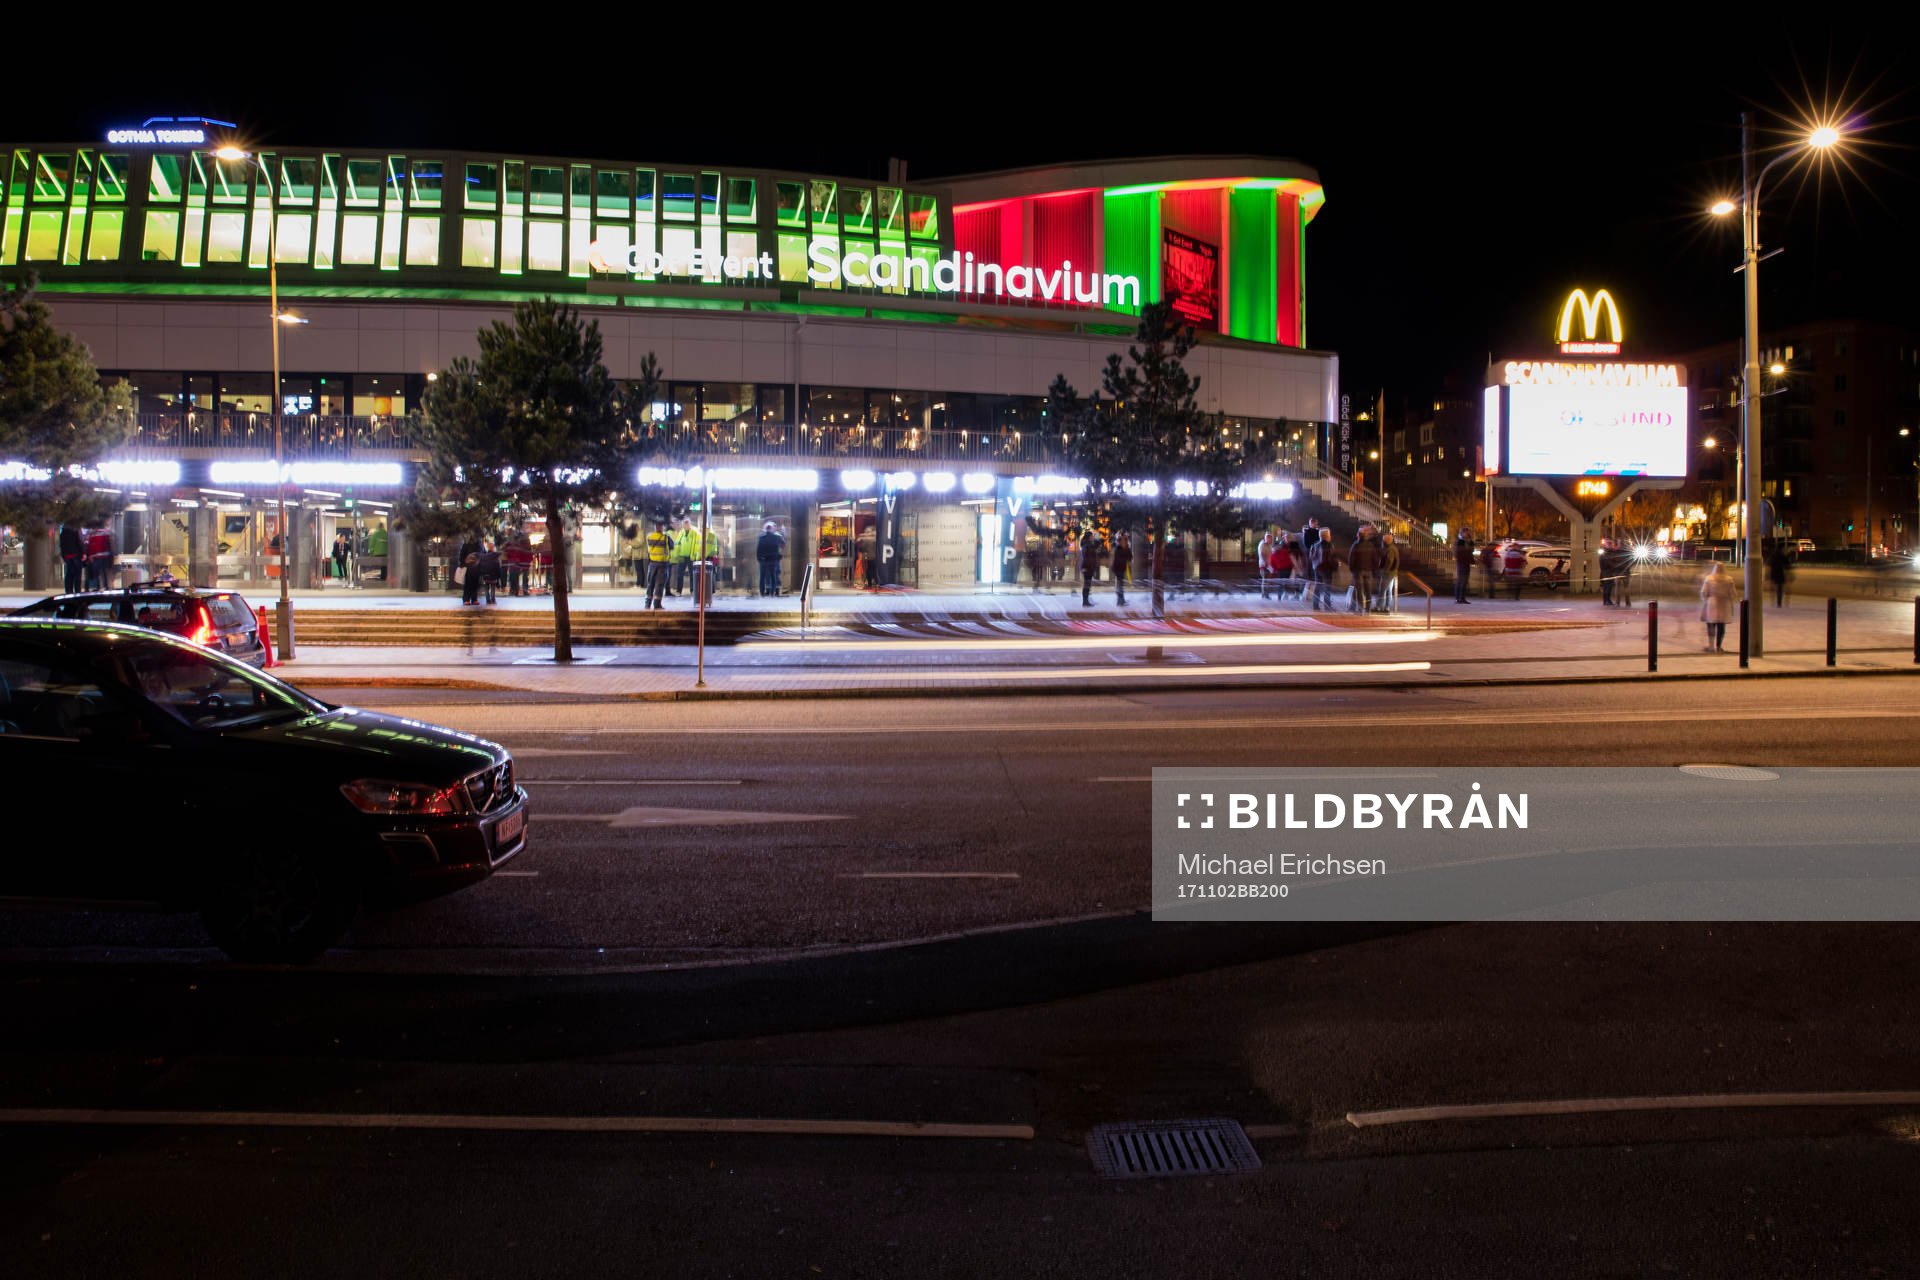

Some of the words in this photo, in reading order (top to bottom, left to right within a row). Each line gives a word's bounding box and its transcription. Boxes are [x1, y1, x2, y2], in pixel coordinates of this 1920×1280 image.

[107, 130, 156, 143] GOTHIA
[687, 247, 773, 280] Event
[807, 237, 1141, 307] Scandinavium
[1505, 361, 1678, 388] SCANDINAVIUM
[882, 494, 897, 564] VIP
[1003, 496, 1023, 565] VIP
